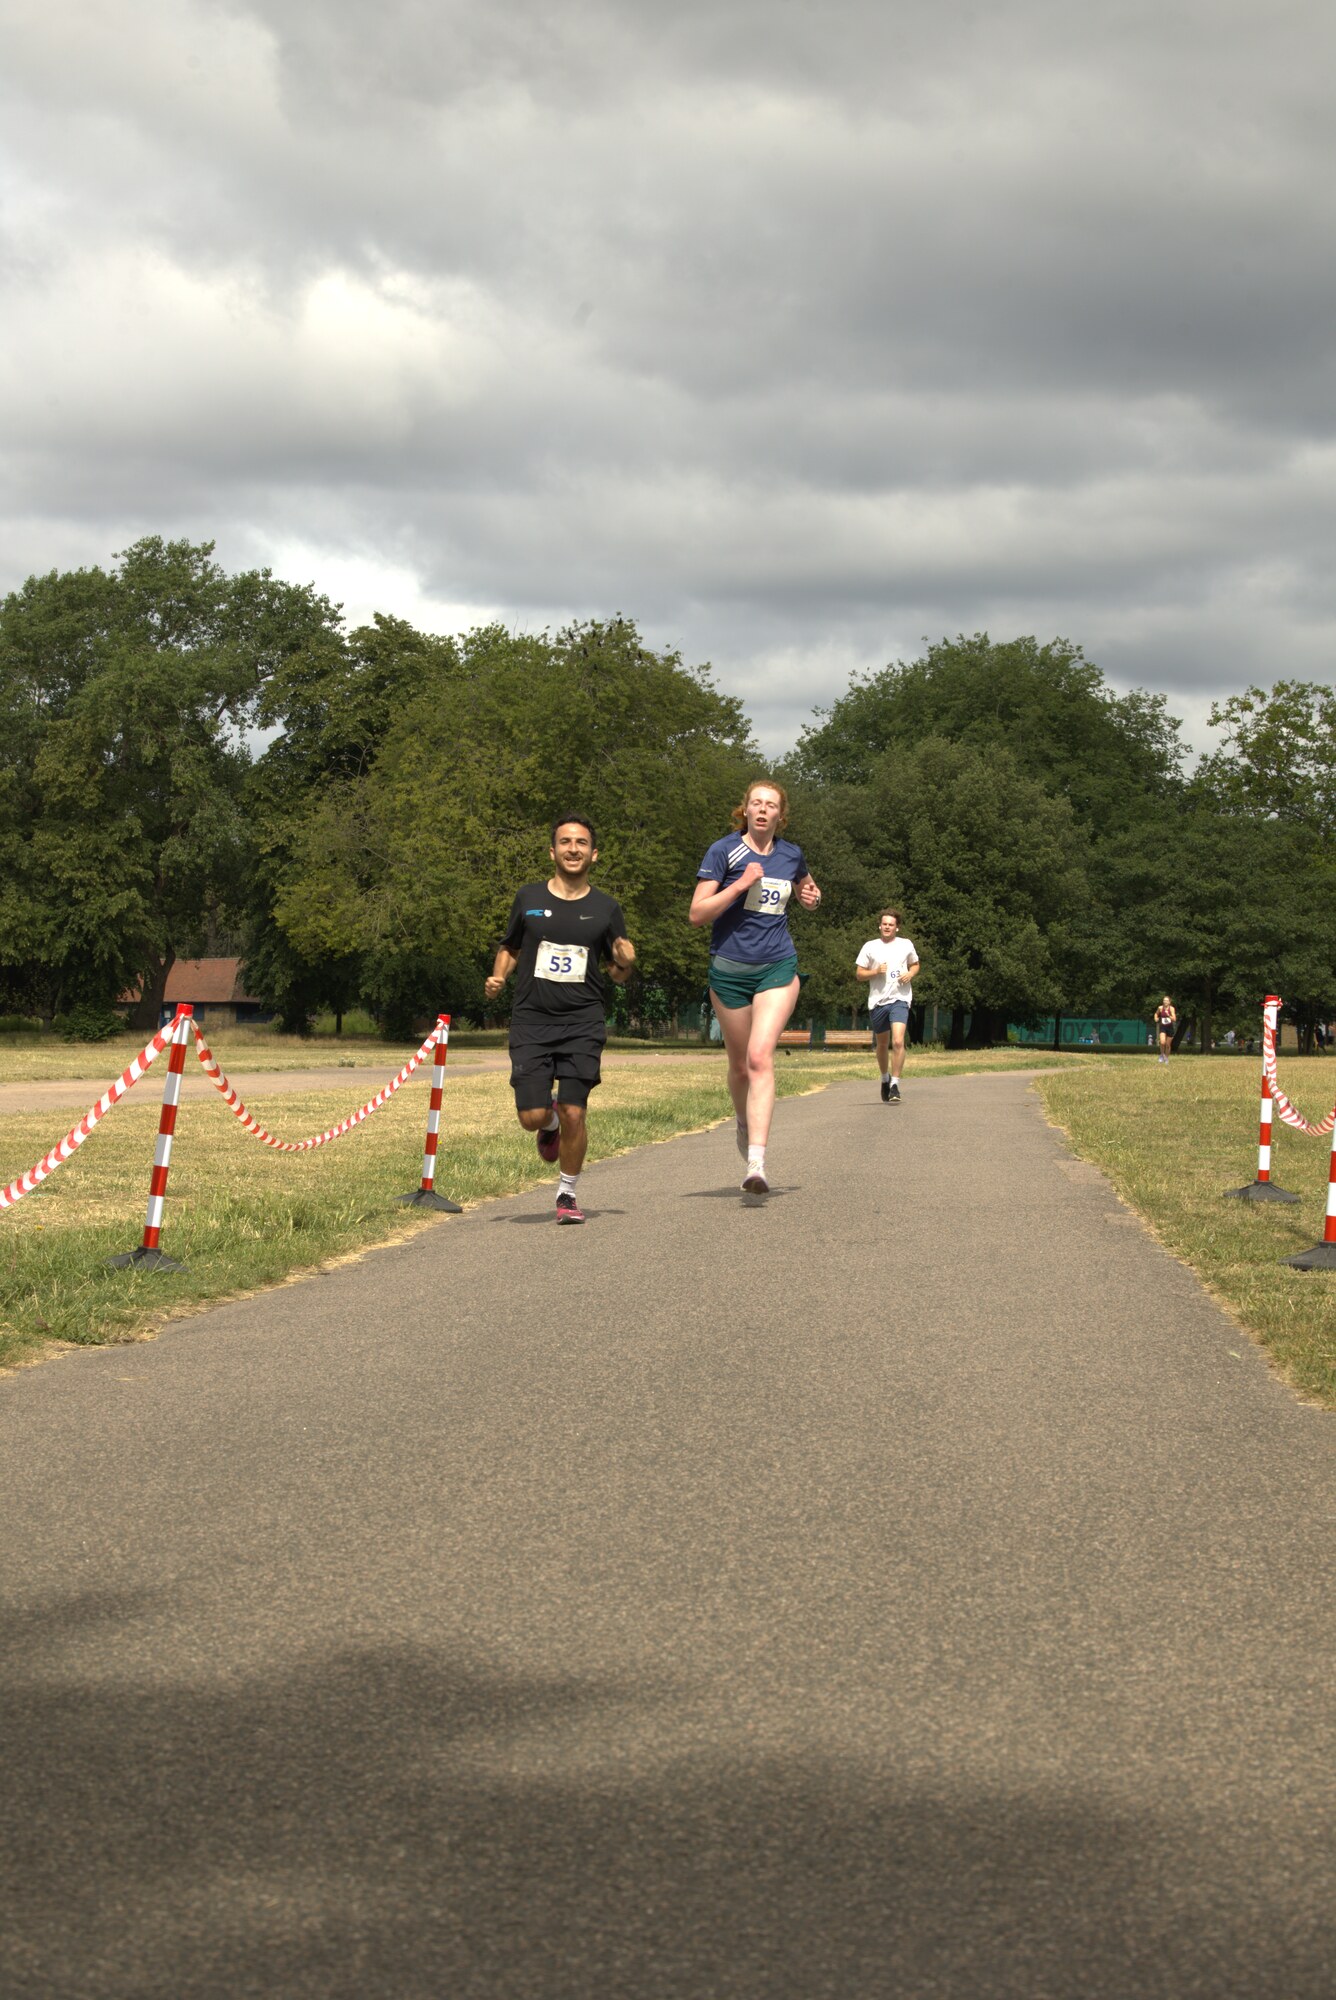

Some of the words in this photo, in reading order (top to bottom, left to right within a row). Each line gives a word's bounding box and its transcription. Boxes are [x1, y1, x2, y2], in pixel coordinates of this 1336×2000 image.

[758, 889, 780, 905] 39
[549, 955, 572, 973] 53
[890, 970, 901, 979] 63
